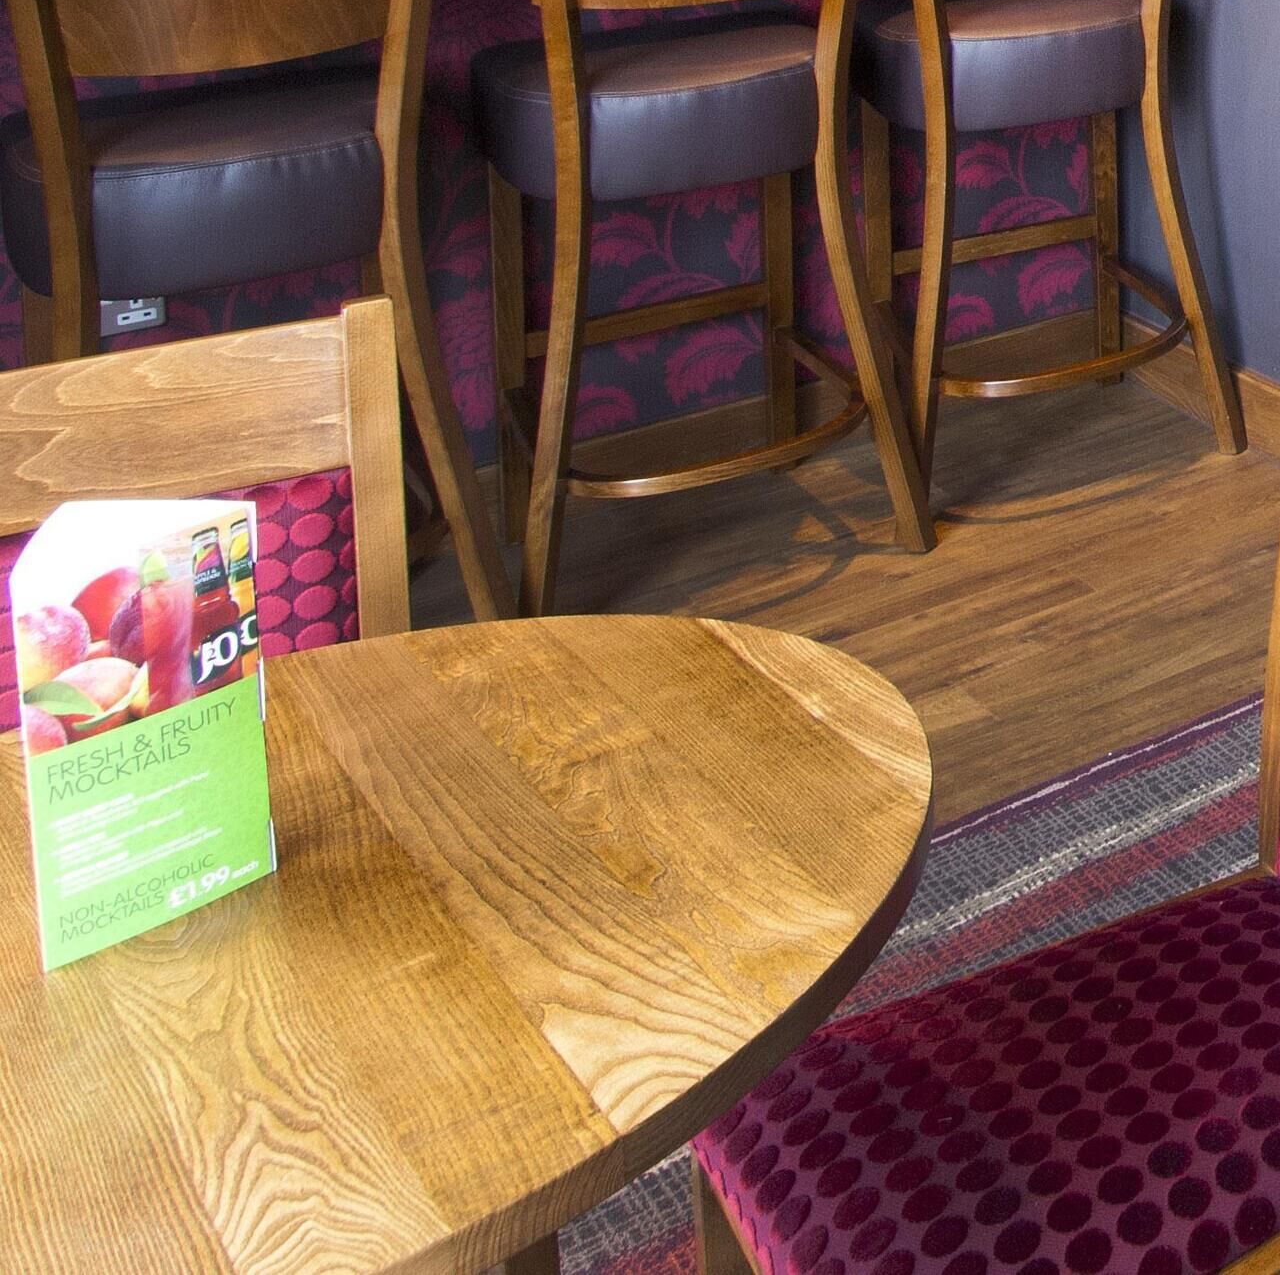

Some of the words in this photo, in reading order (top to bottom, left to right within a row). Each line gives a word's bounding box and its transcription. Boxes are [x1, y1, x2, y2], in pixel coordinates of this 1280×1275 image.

[47, 740, 125, 786] FRESH
[133, 733, 152, 754] &
[160, 696, 237, 743] FRUITY
[49, 737, 192, 806] MOCKTAILS
[59, 852, 216, 929] NON-ALCOHOLIC
[60, 890, 165, 945] MOCKTAILS
[168, 864, 231, 910] £1.99
